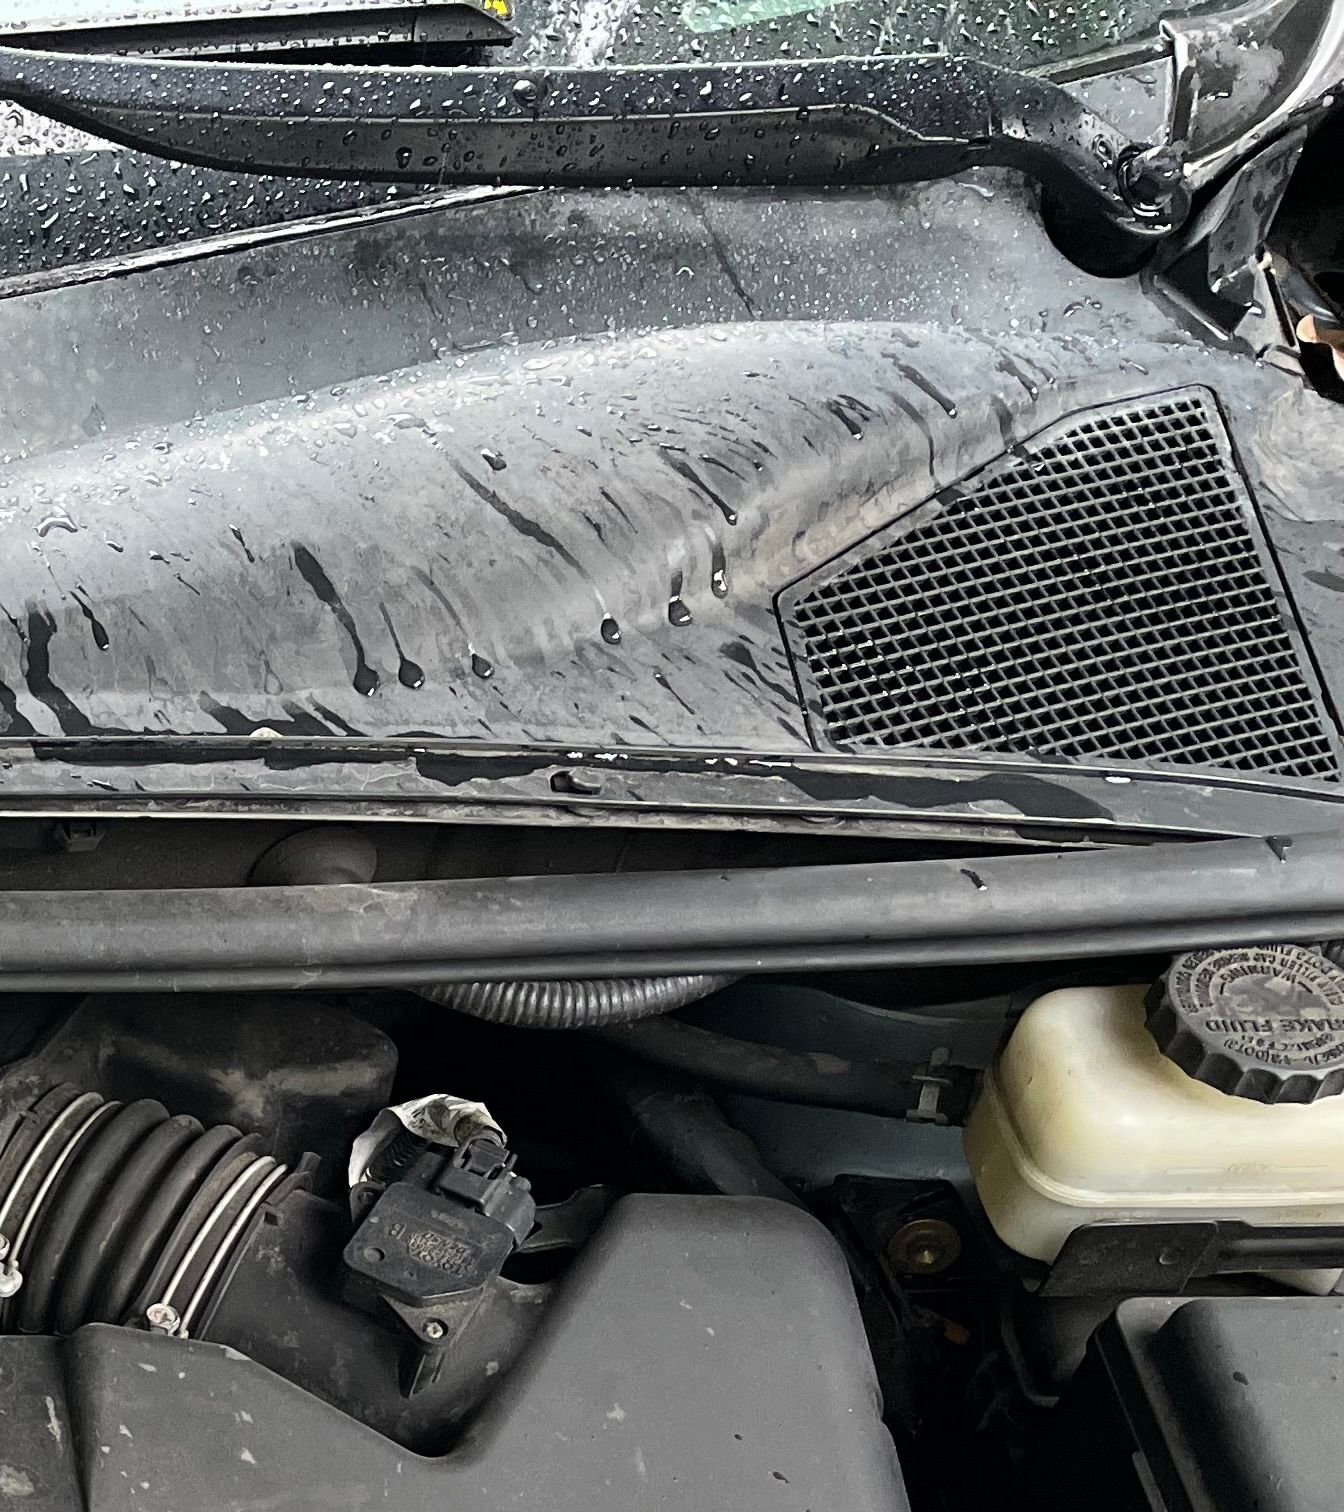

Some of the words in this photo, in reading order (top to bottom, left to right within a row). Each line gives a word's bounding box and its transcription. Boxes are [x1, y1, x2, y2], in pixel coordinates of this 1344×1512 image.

[1220, 964, 1297, 984] WARNING
[1205, 1019, 1273, 1033] FLUID
[1278, 1019, 1344, 1033] RAKE
